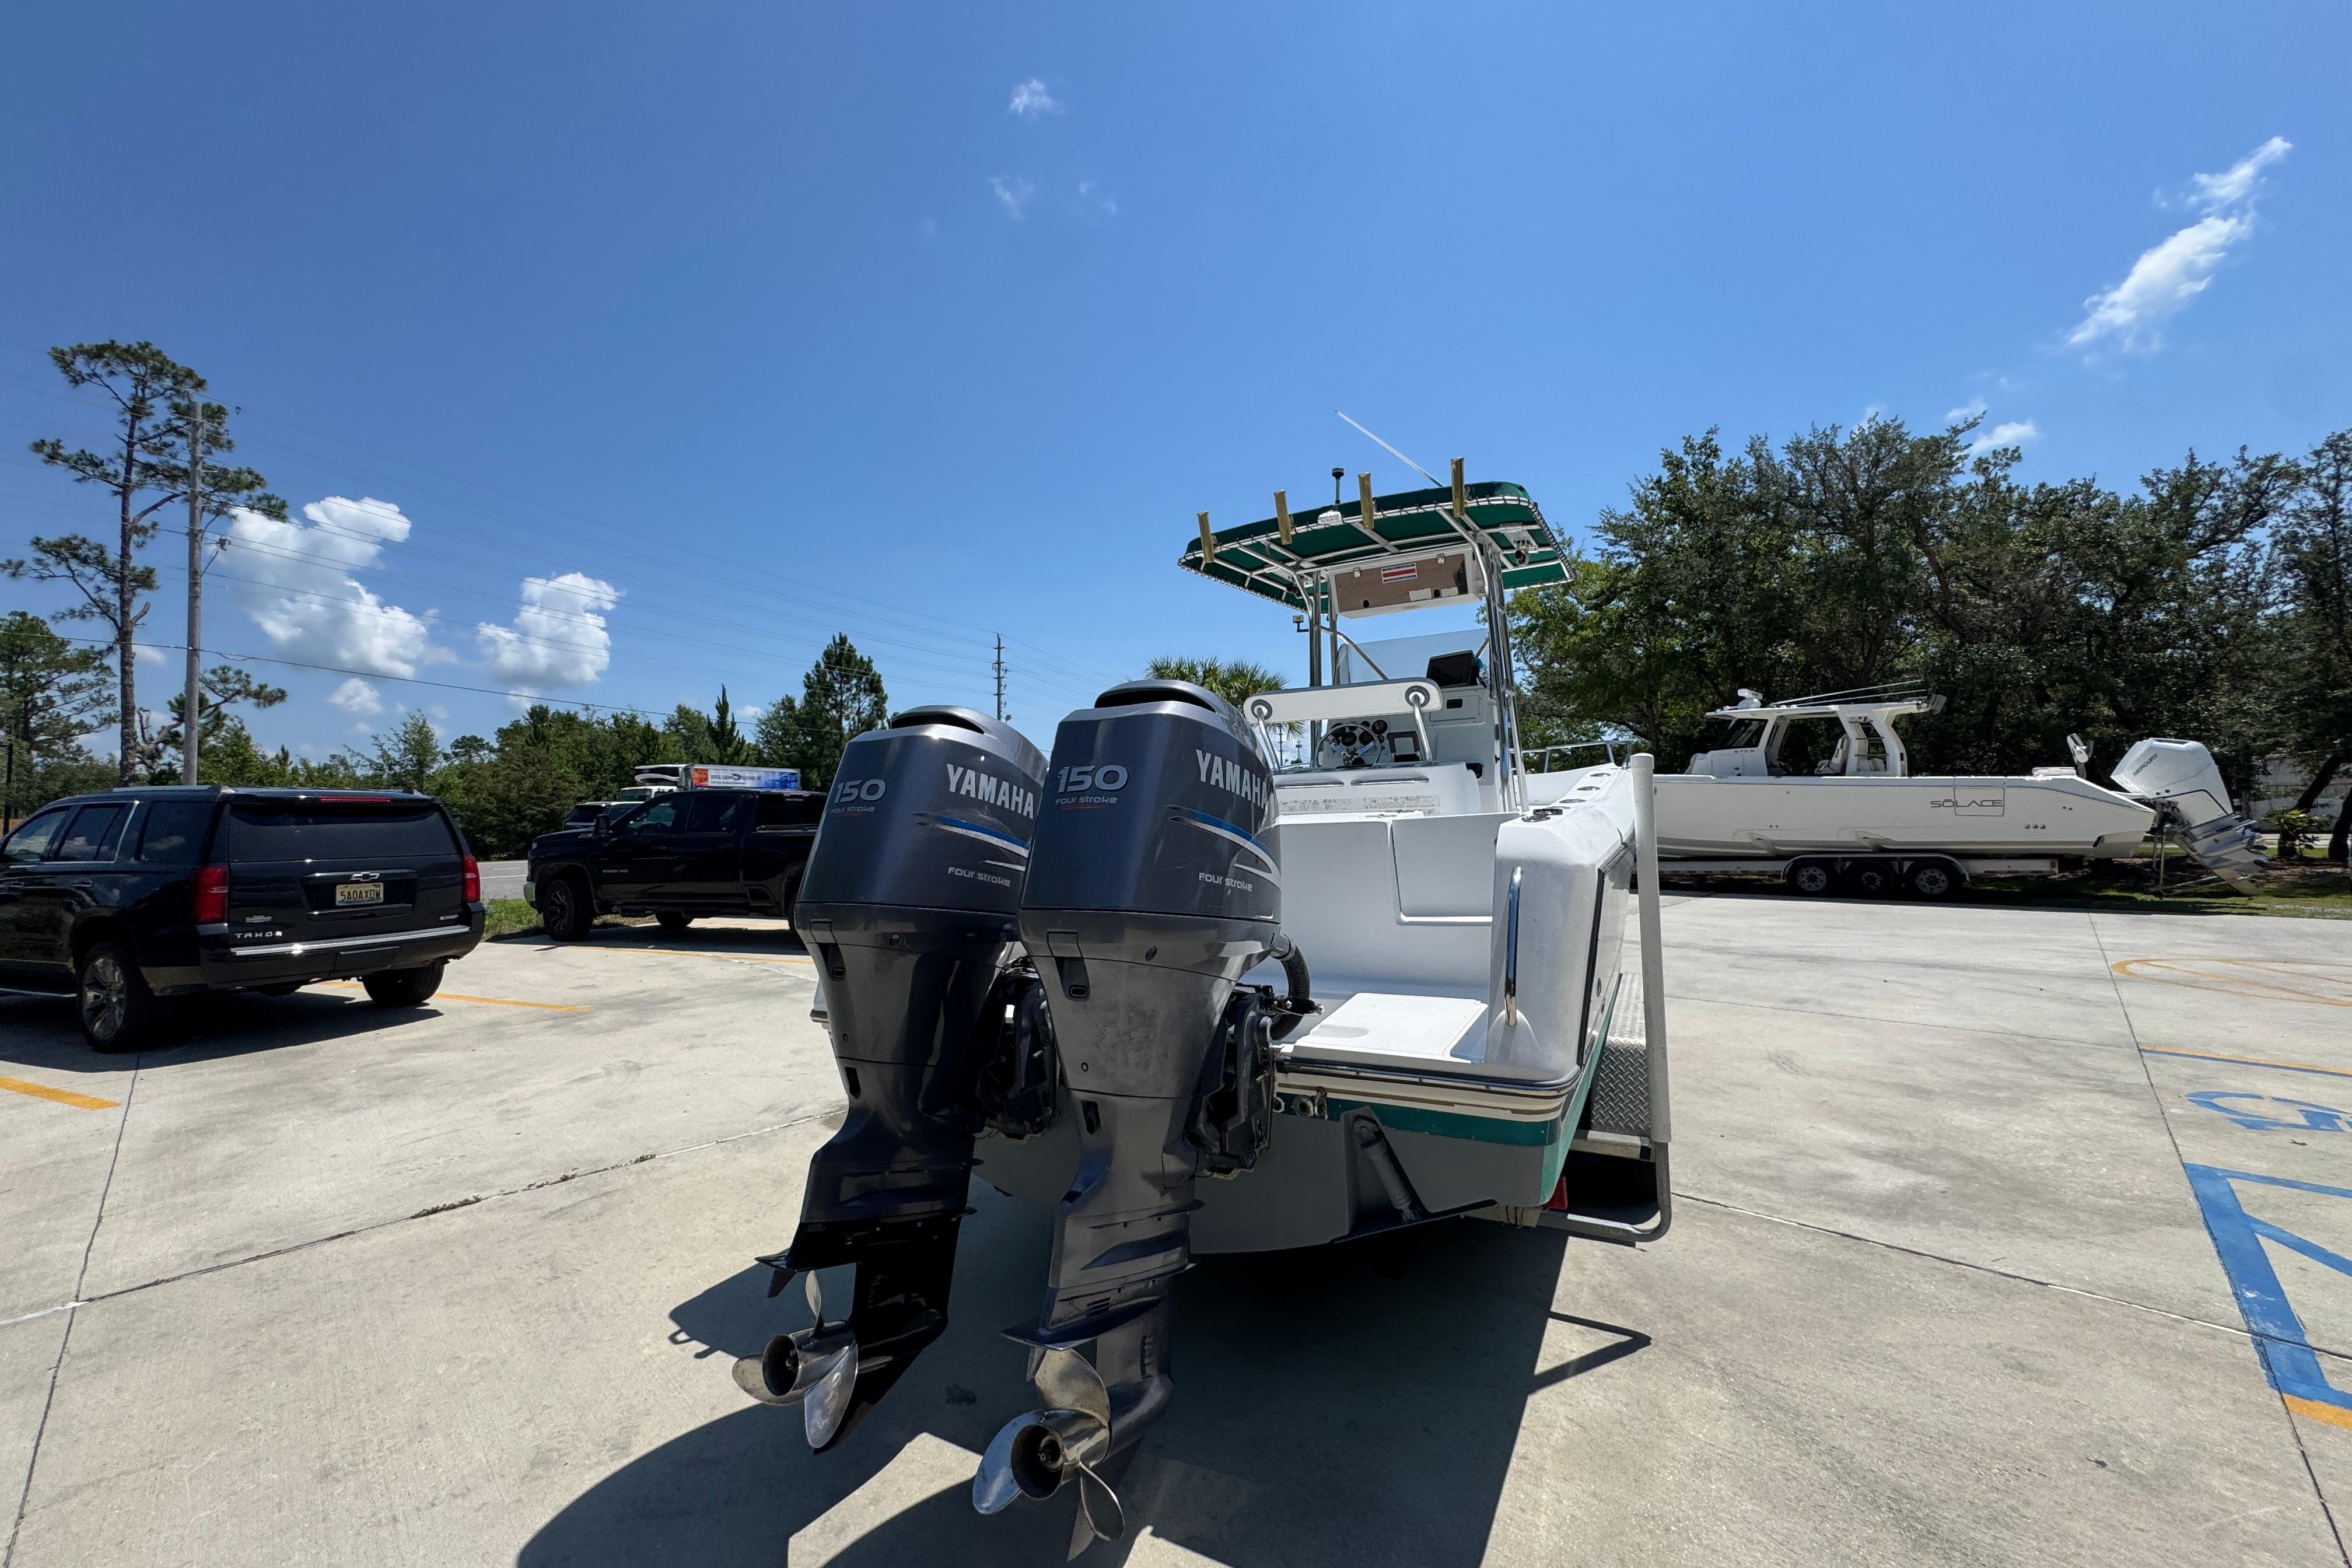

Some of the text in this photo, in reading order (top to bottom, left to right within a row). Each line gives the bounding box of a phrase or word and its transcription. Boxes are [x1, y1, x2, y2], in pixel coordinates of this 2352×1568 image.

[834, 779, 886, 803] 150
[947, 764, 1034, 820] YAMAHA
[1058, 765, 1128, 793] 150
[1196, 749, 1269, 810] YAMAHA
